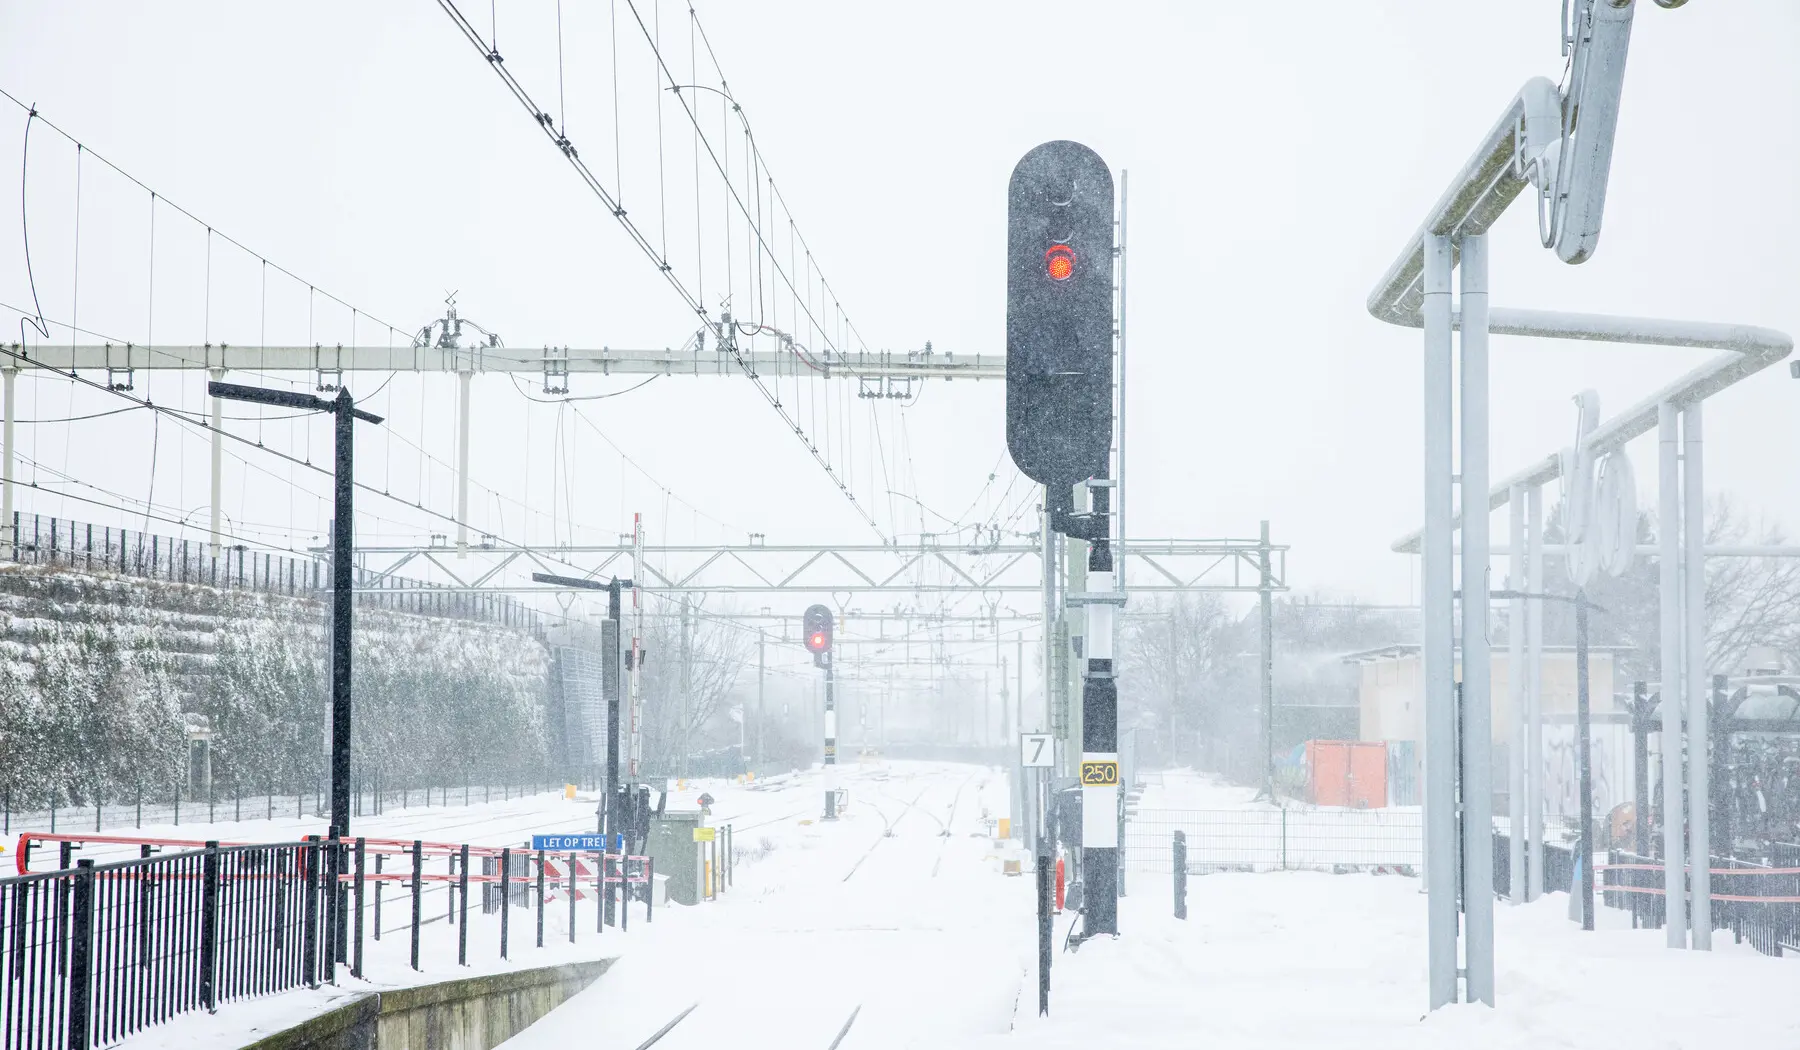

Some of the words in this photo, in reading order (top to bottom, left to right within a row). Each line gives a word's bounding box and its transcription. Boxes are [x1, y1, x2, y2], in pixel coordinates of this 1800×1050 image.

[1030, 738, 1046, 763] 7
[1084, 765, 1115, 782] 250
[835, 791, 844, 804] 7
[543, 837, 561, 848] LET
[563, 837, 579, 848] OP
[581, 837, 604, 847] TREI
